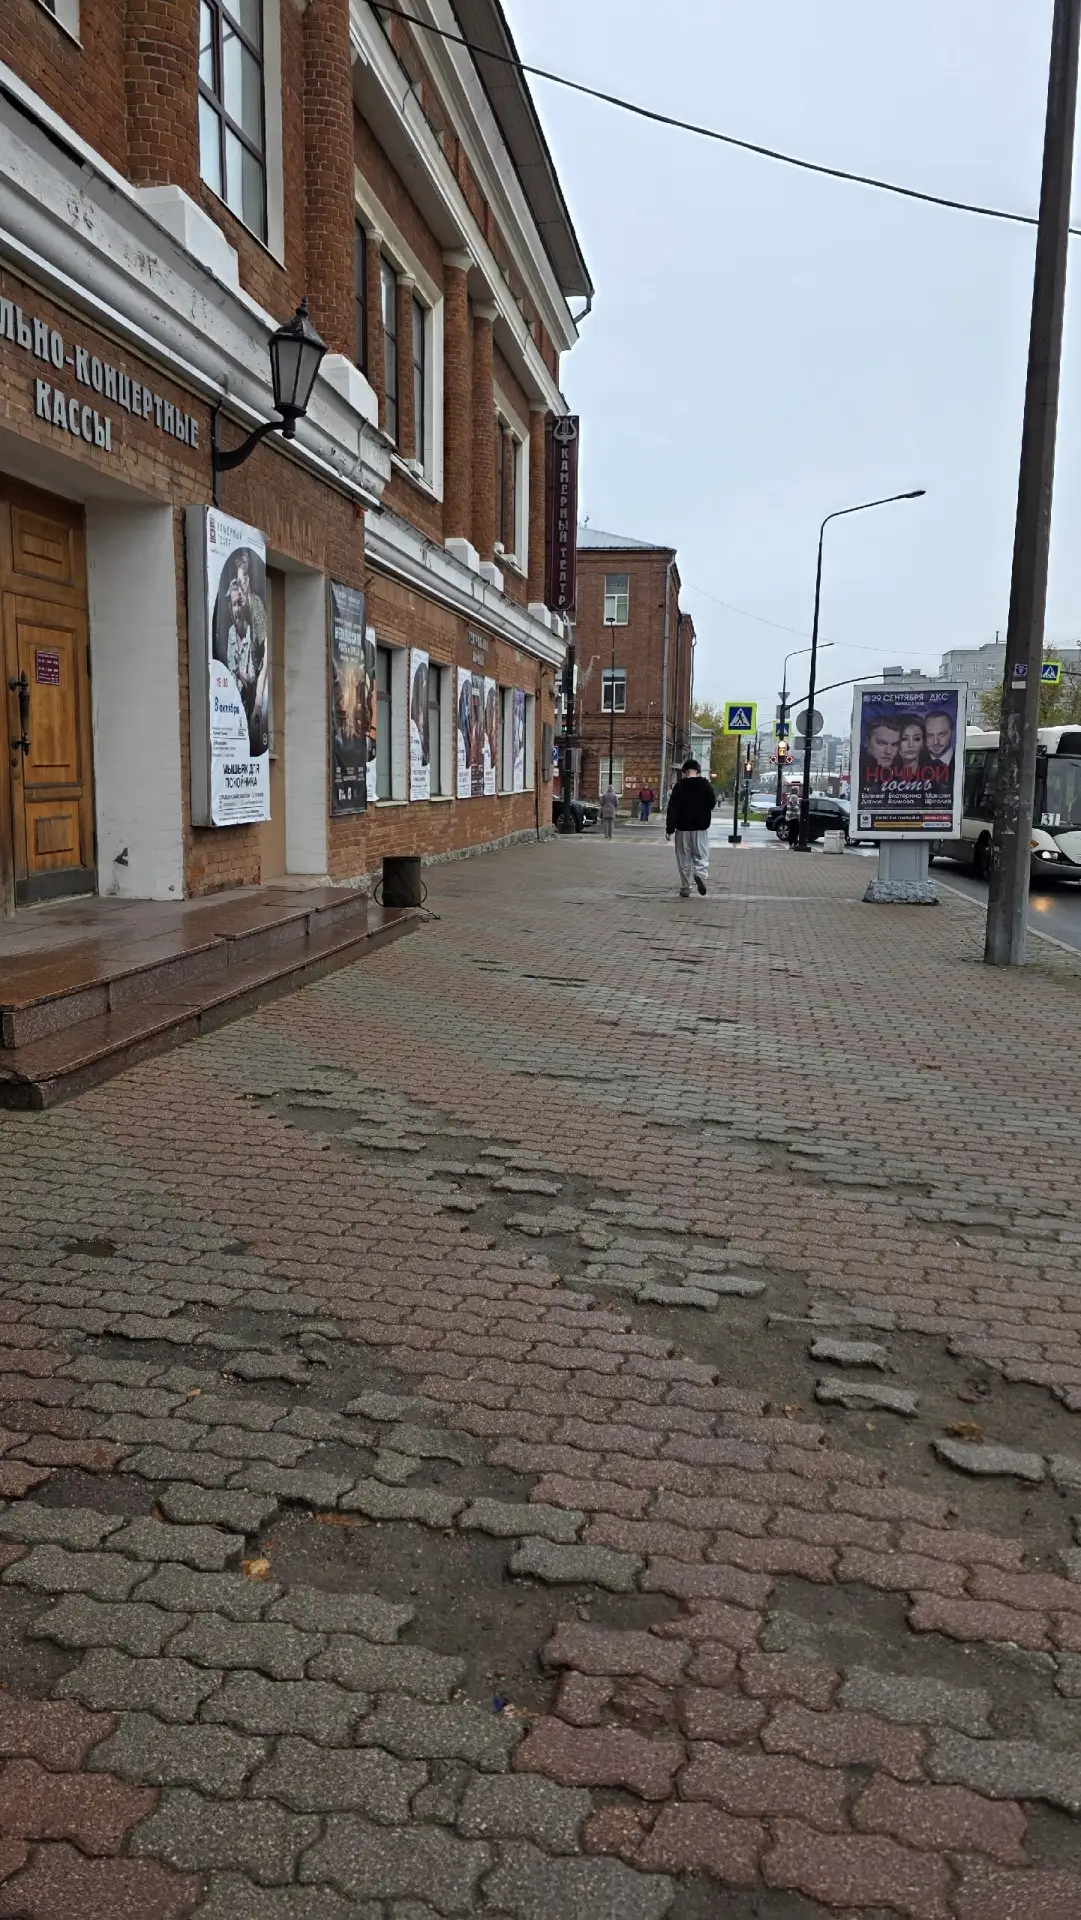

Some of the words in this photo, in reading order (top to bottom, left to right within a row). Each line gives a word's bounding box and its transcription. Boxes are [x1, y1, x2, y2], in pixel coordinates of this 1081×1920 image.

[0, 296, 199, 449] ЛЬНО-КОНЦЕРТНЫЕ
[36, 378, 112, 452] КАССЫ
[558, 448, 569, 543] КАМЕРНЫЙ
[558, 548, 568, 605] ТЕАТР
[214, 696, 219, 712] 8
[871, 694, 882, 702] 29
[882, 693, 924, 702] СЕНТЯБРЯ
[929, 692, 949, 702] ДКС
[866, 765, 949, 782] НОЧНОЙ
[881, 779, 932, 791] гость
